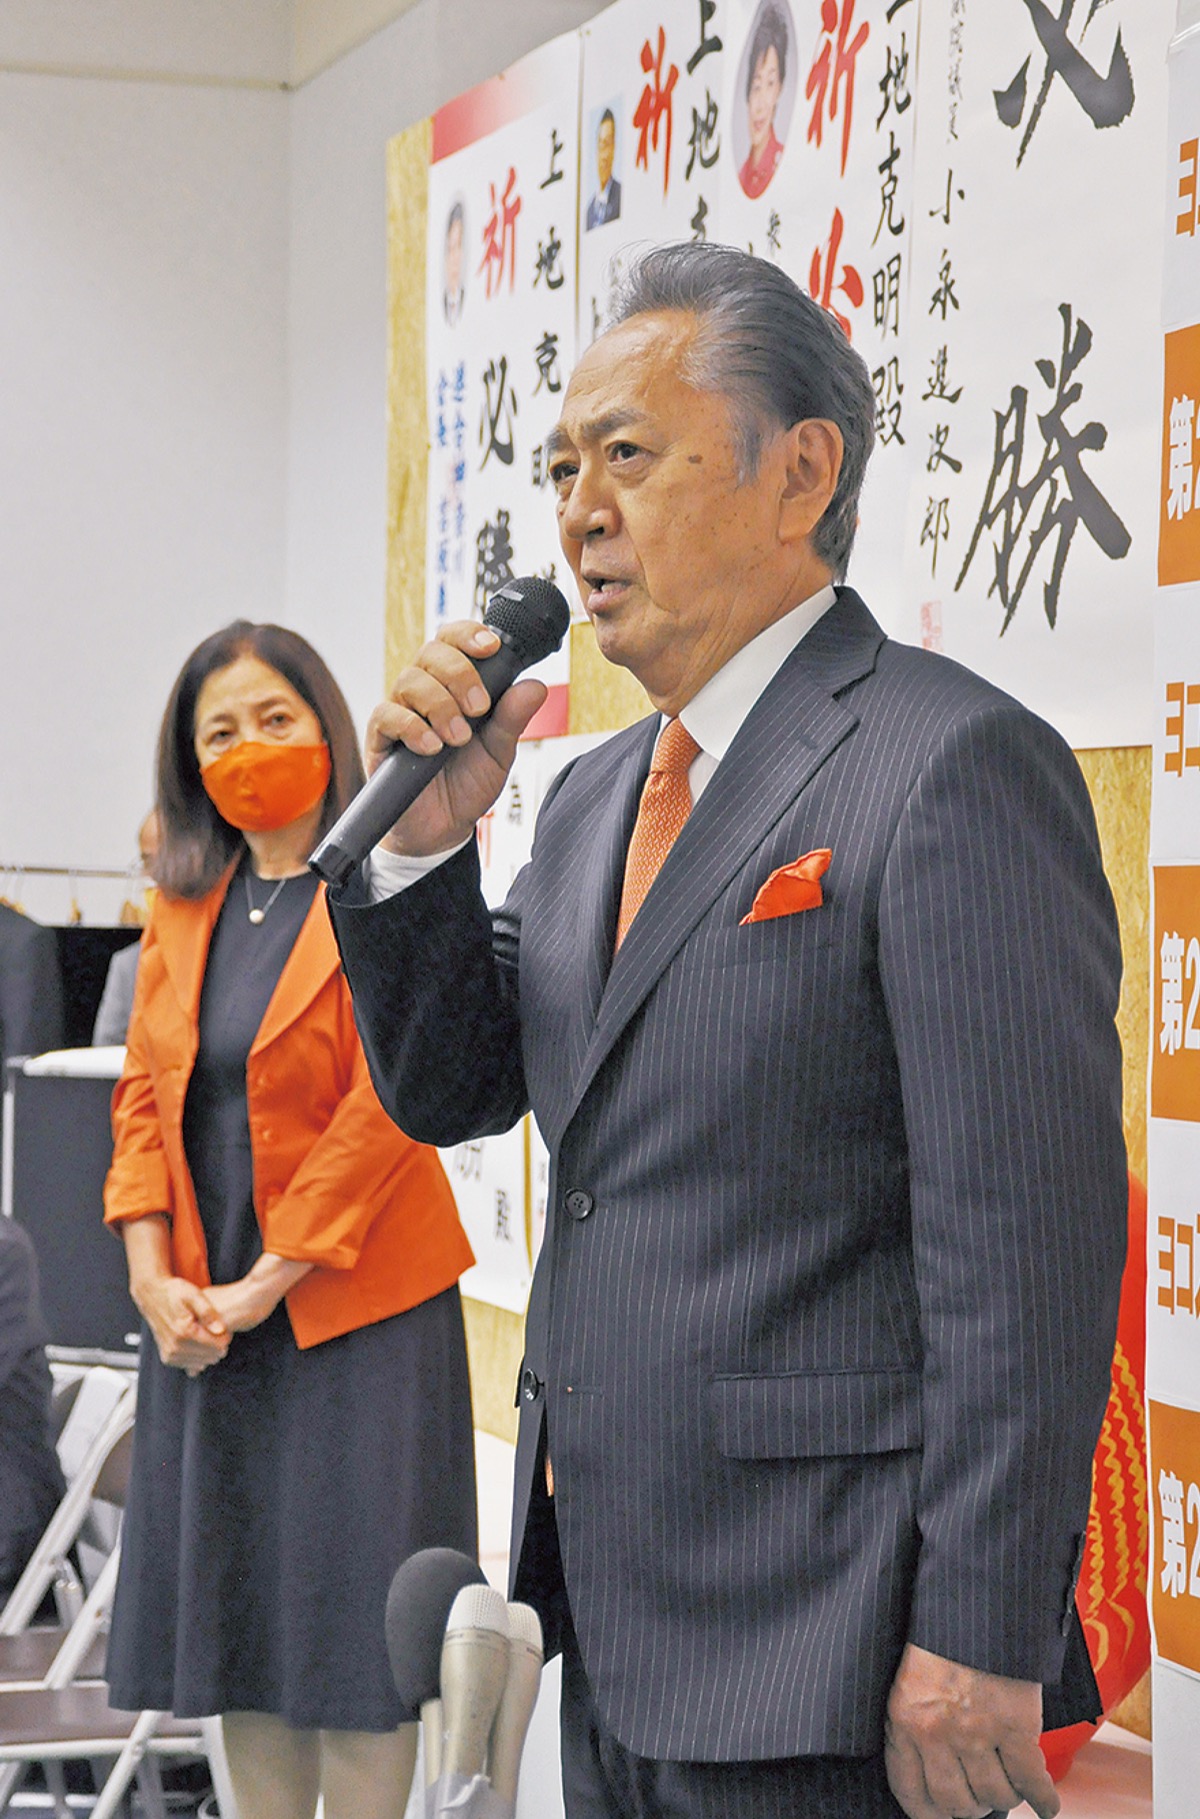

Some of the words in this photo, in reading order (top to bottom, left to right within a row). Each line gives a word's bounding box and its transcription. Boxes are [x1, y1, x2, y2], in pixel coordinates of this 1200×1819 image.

[632, 25, 680, 205] 祈
[870, 0, 914, 446] 地克明殿
[1167, 394, 1200, 520] 第
[1158, 1213, 1200, 1320] ヨコ
